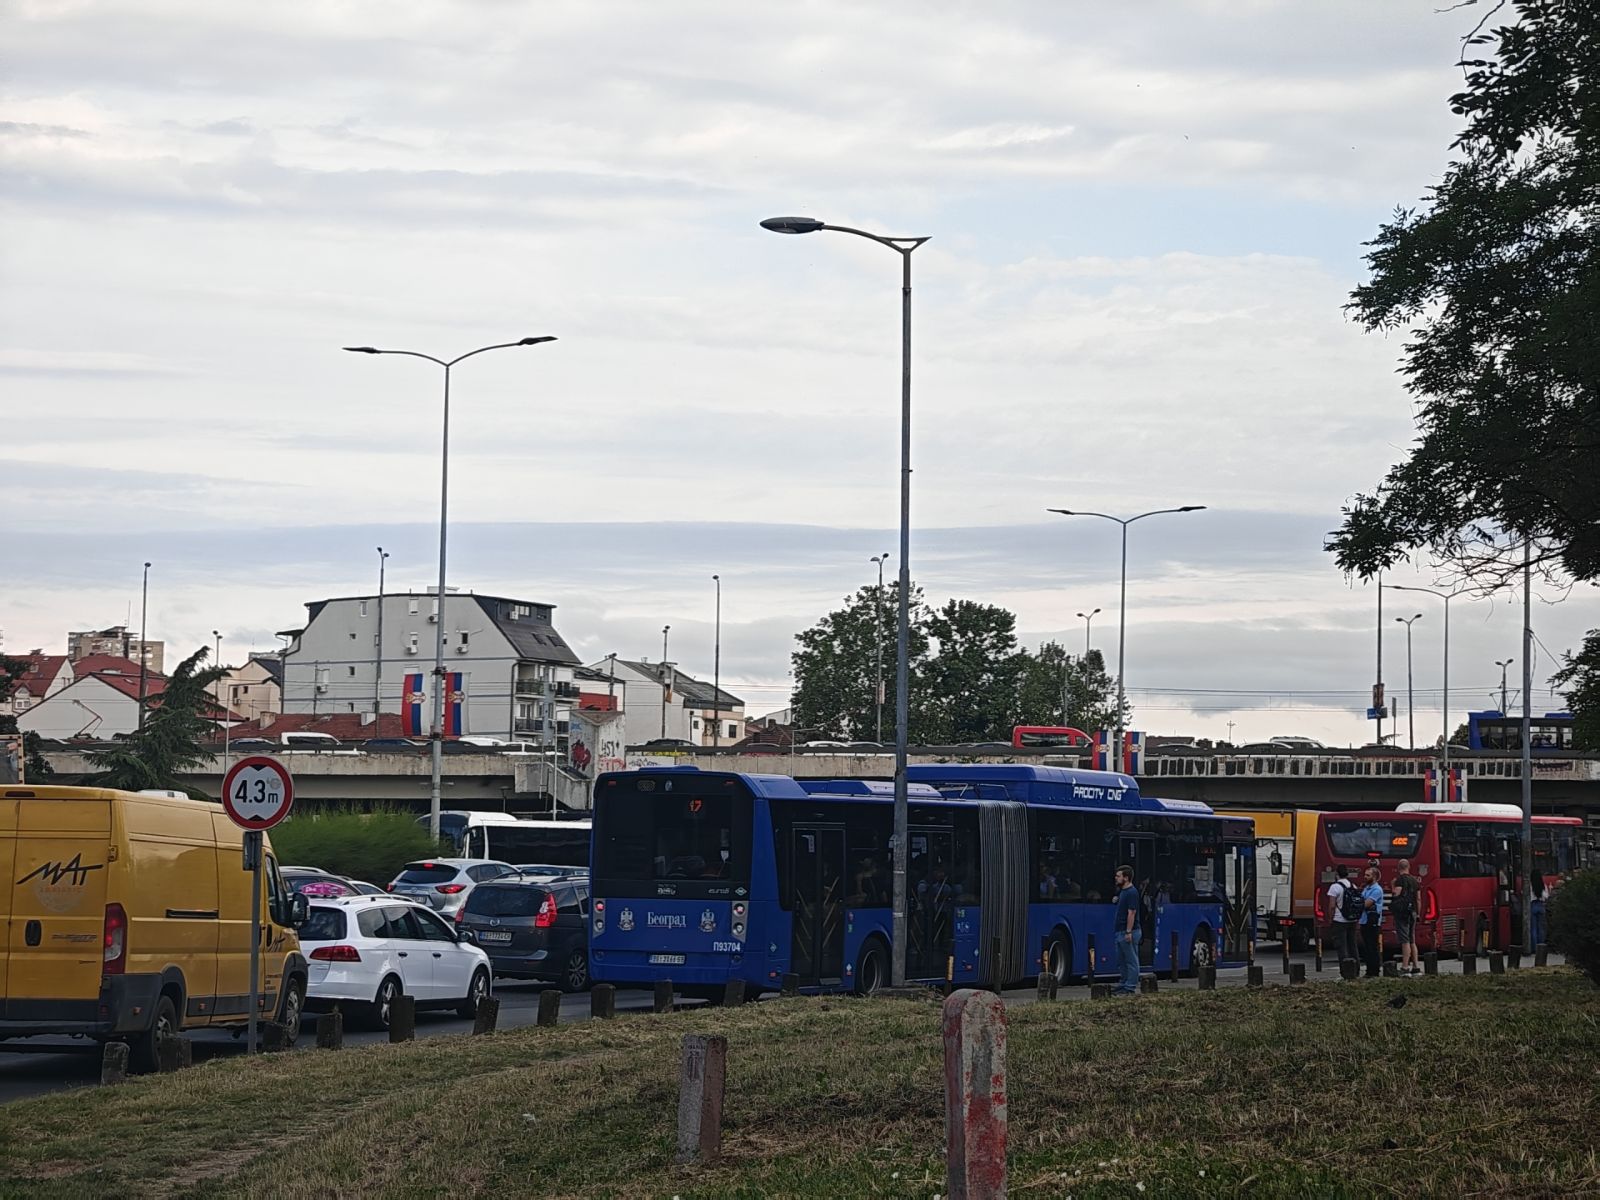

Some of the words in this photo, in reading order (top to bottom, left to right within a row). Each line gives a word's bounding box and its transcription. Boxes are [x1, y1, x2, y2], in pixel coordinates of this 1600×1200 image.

[1073, 787, 1104, 800] PROCITY
[1107, 789, 1121, 801] CNG
[16, 853, 103, 885] MAT
[647, 911, 687, 929] Београд
[713, 941, 741, 952] П93704
